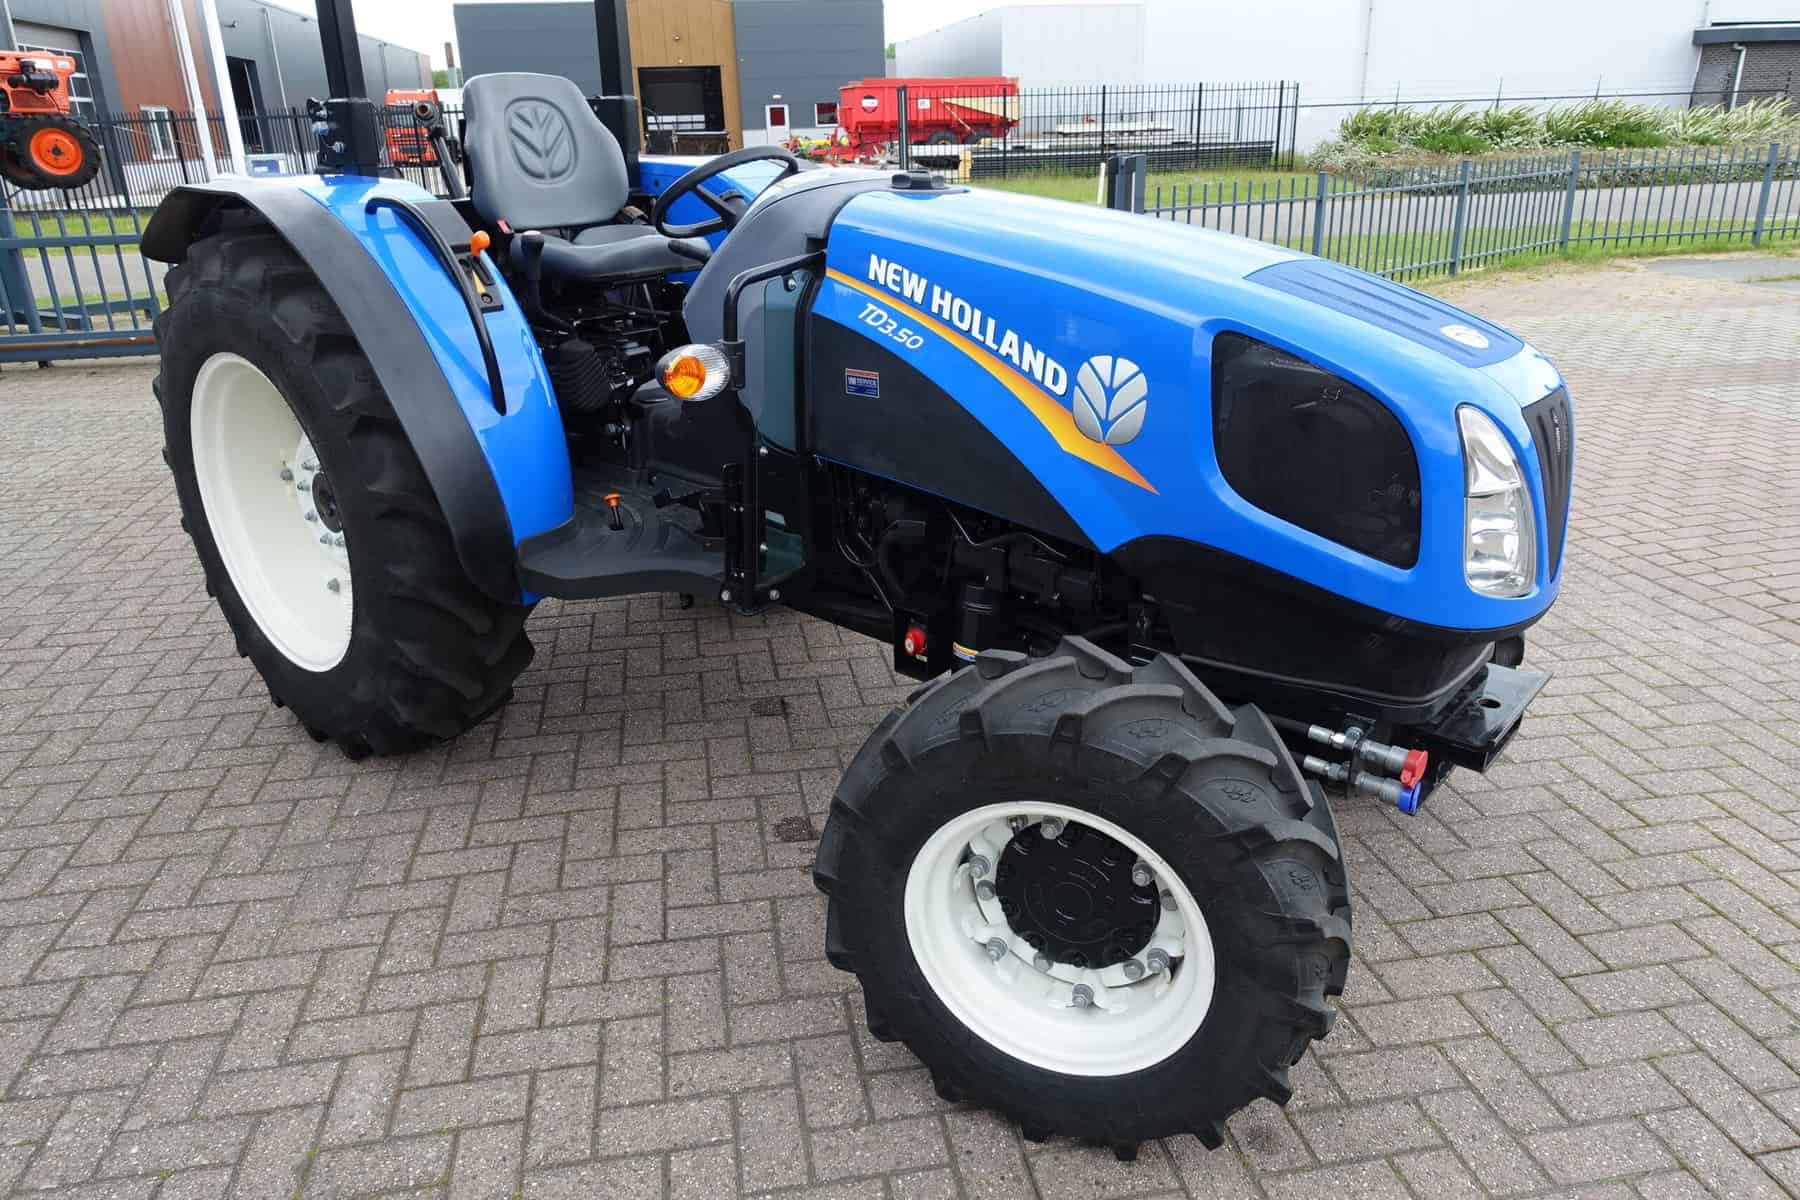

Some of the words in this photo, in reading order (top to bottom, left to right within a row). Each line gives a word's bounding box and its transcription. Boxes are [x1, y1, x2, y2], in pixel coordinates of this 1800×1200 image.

[858, 303, 924, 348] TD3.50
[868, 254, 927, 303] NEW
[931, 285, 1068, 395] HOLLAND
